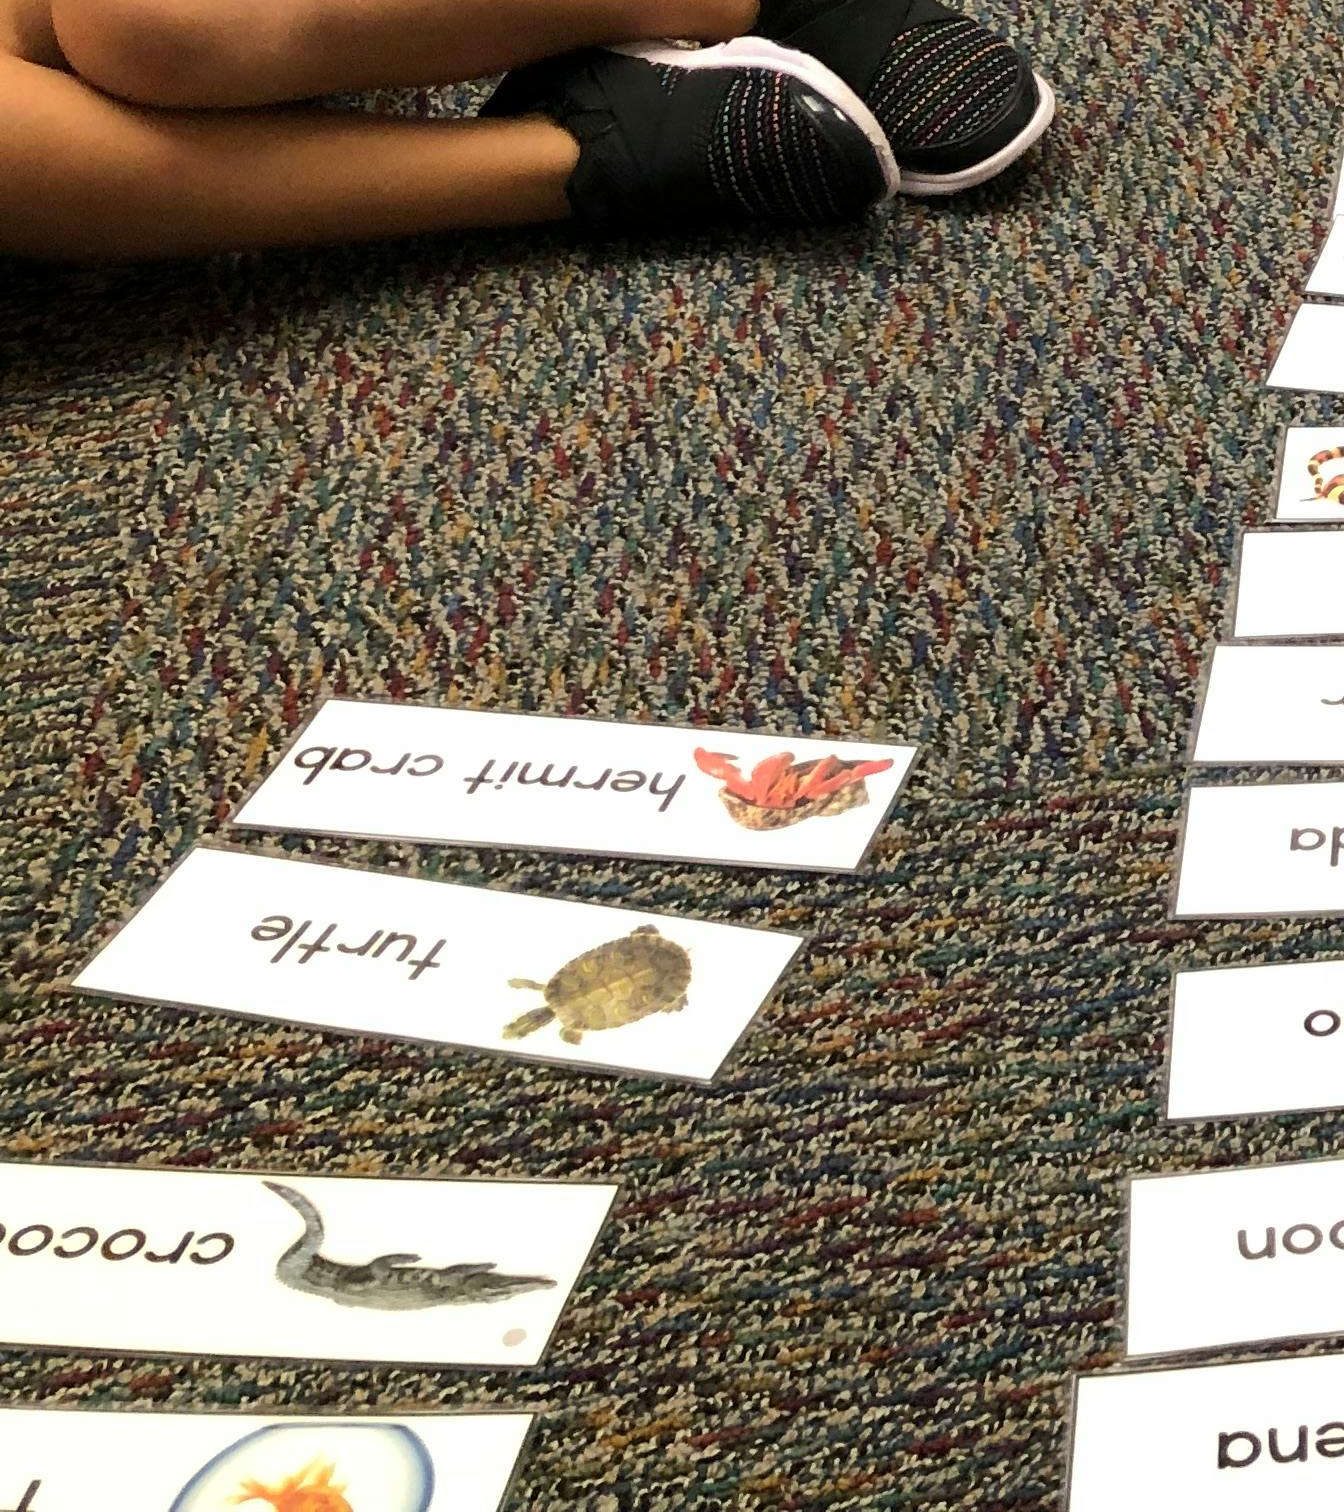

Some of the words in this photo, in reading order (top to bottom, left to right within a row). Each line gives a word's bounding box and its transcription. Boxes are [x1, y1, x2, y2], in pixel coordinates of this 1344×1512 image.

[294, 747, 444, 785] crab
[464, 760, 686, 812] hermit
[251, 916, 446, 980] turtle
[0, 1223, 234, 1265] croco
